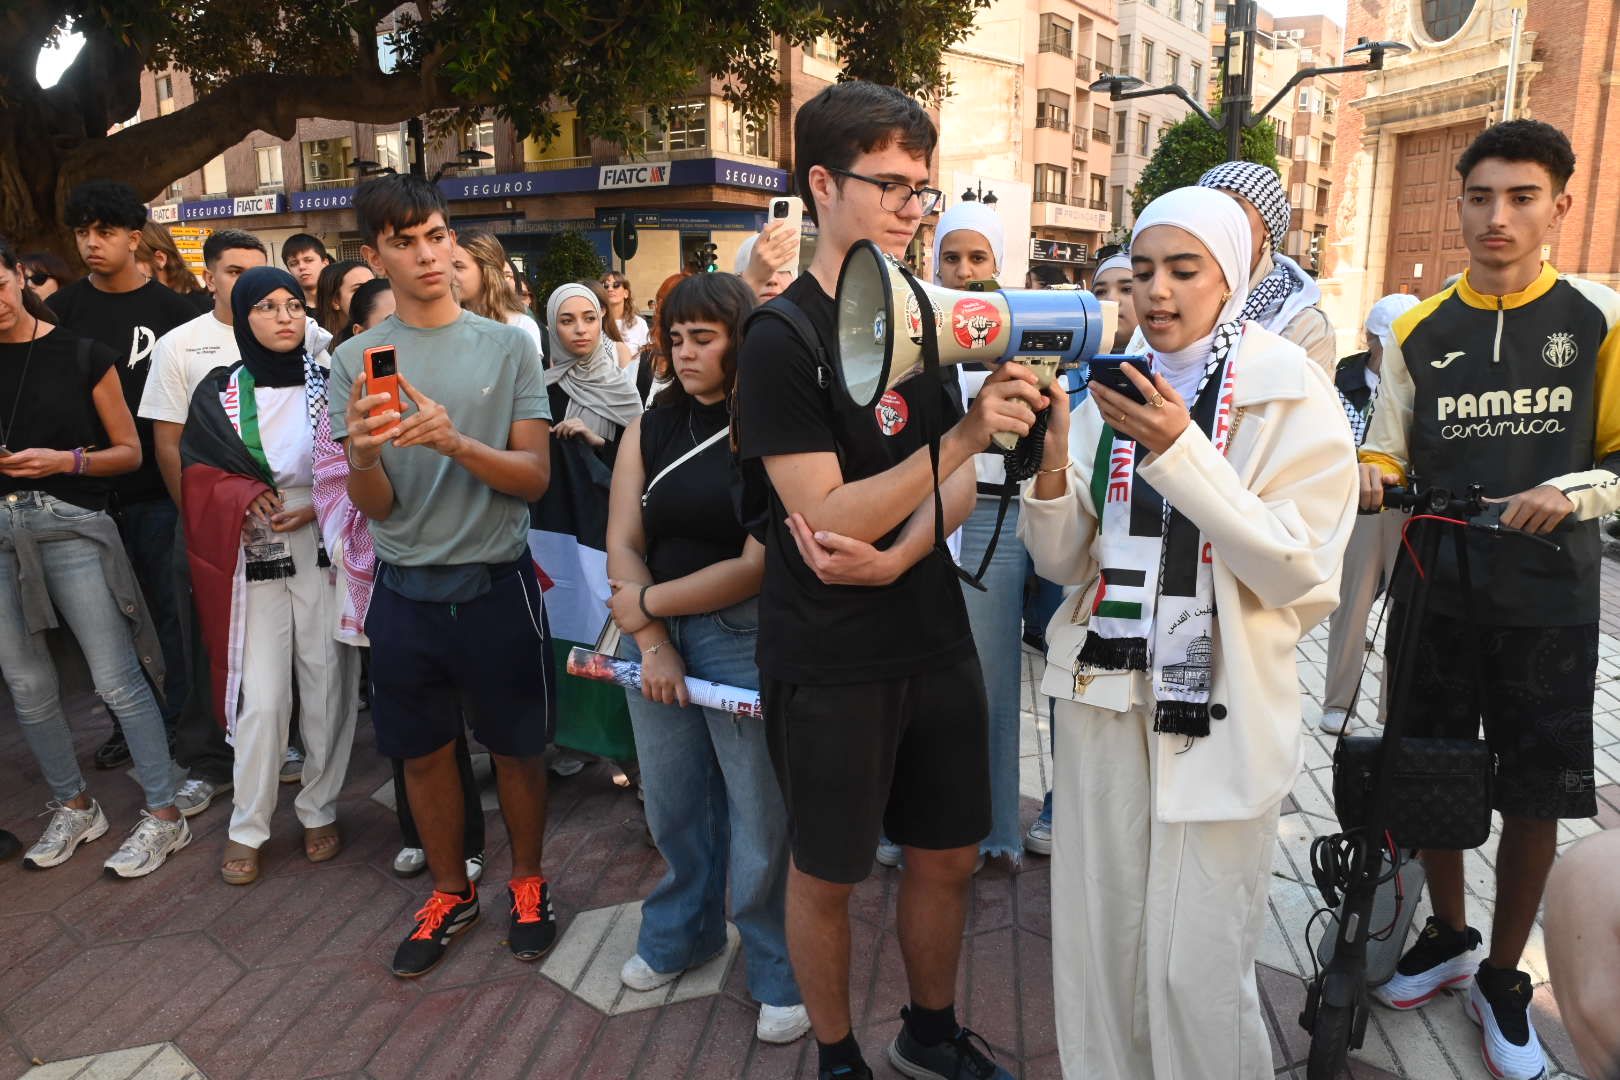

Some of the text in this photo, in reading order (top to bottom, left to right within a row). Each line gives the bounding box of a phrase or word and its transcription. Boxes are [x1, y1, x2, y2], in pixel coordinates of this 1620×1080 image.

[603, 167, 647, 186] FIATC
[725, 169, 779, 188] SEGUROS
[463, 180, 533, 196] SEGUROS
[186, 199, 263, 218] SEGUROS FIATC
[1437, 386, 1573, 421] PAMESA
[1441, 418, 1566, 440] cerámica
[1108, 440, 1135, 503] INE
